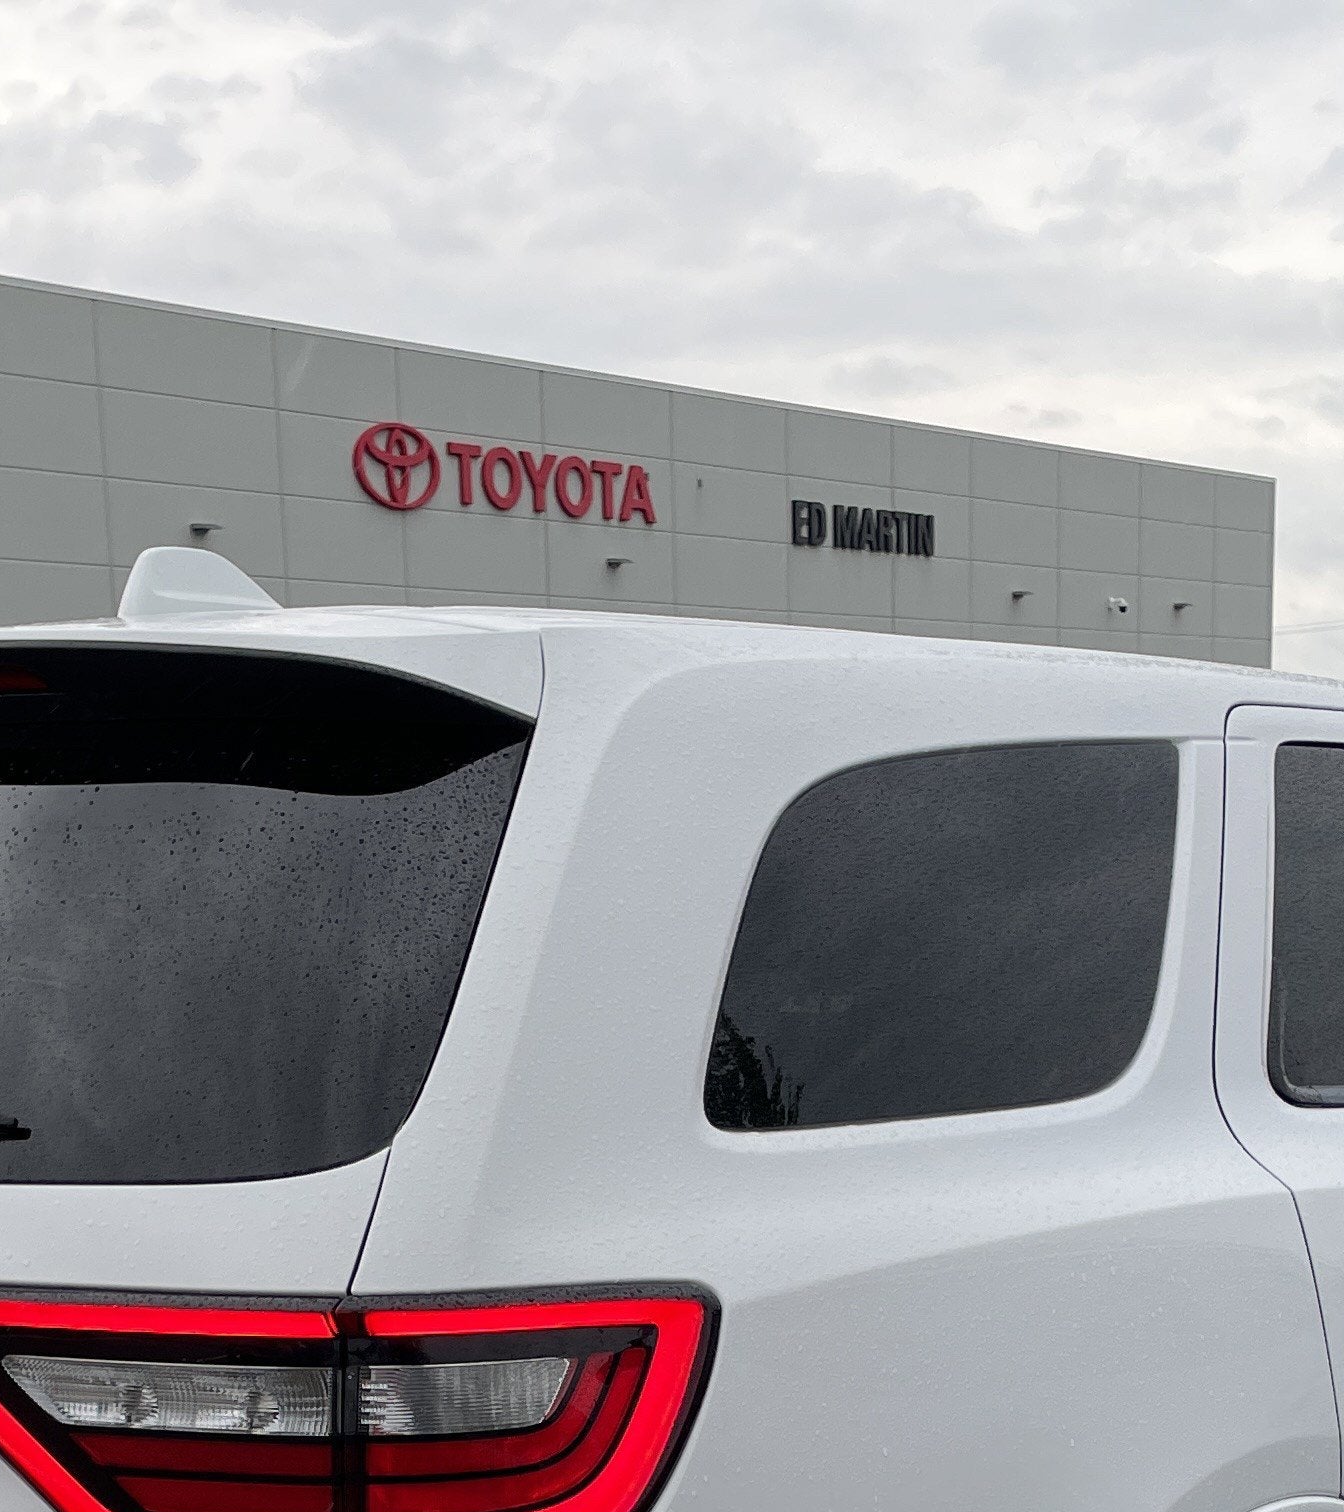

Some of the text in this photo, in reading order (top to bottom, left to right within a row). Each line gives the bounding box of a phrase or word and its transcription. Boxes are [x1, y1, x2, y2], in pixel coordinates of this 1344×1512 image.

[446, 441, 657, 525] TOYOTA
[790, 499, 936, 559] ED MARTIN
